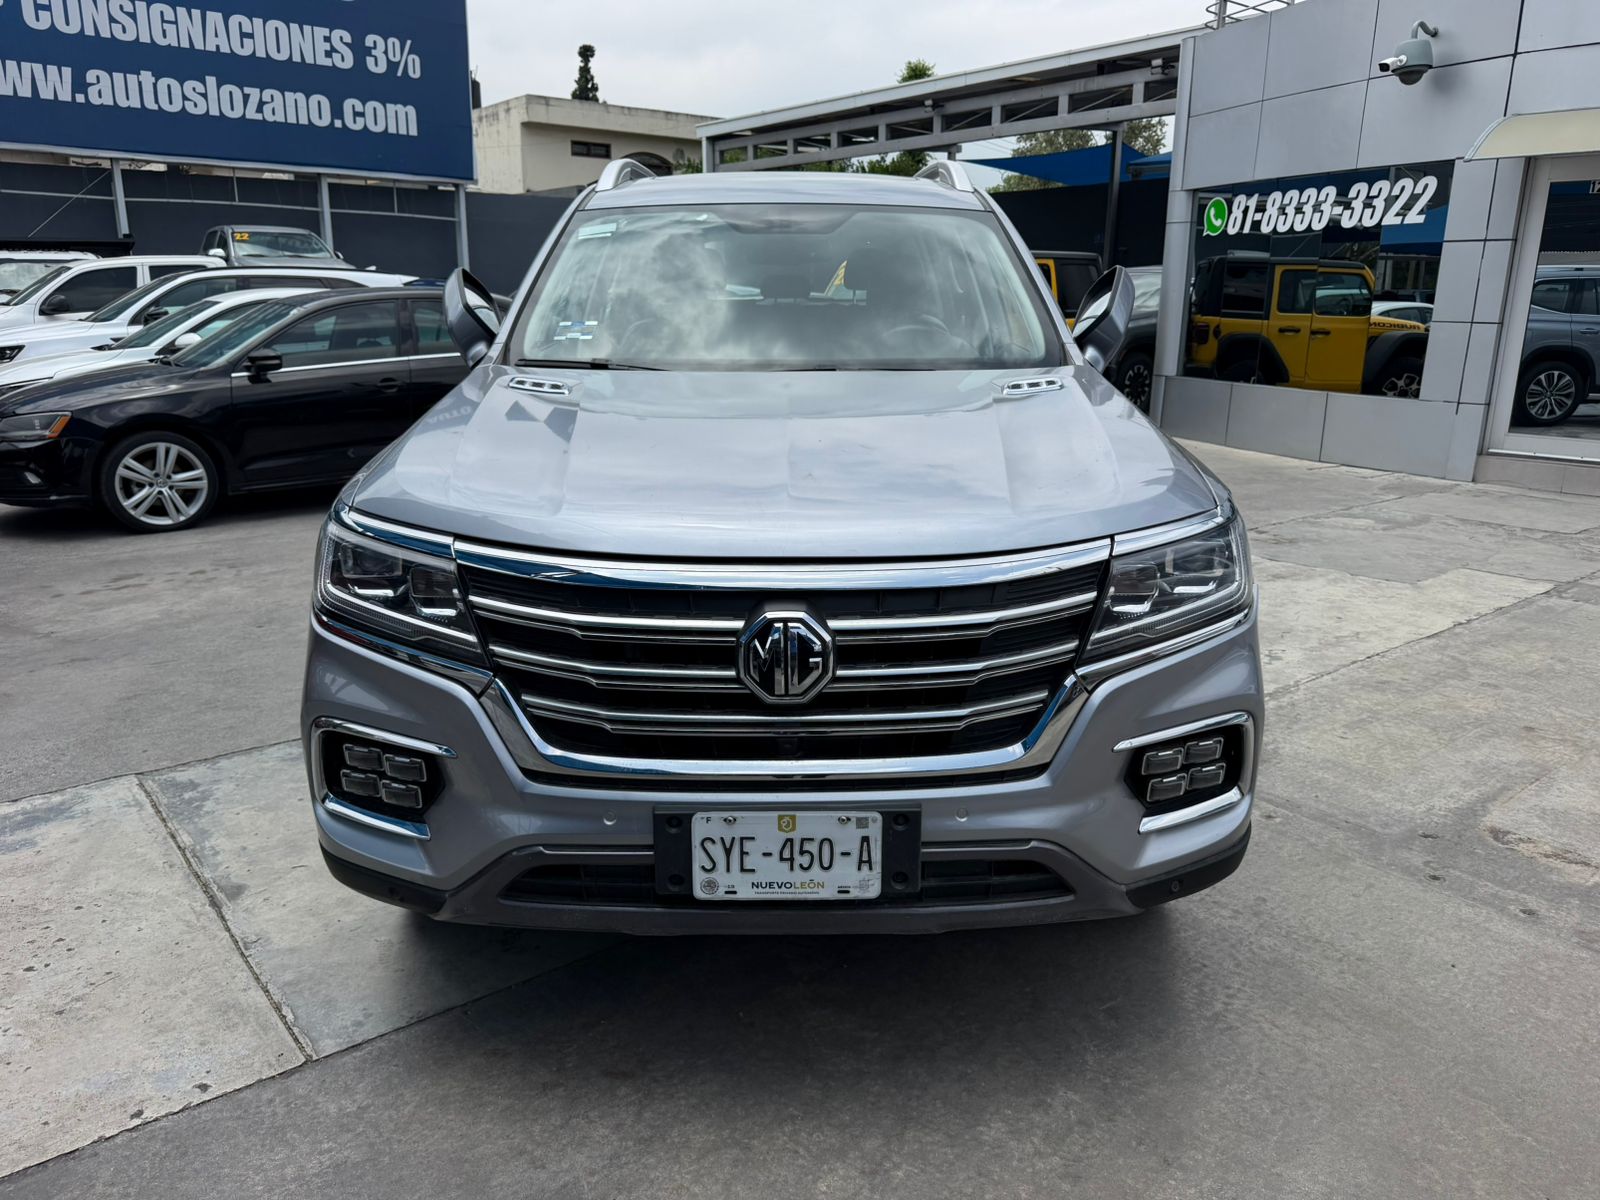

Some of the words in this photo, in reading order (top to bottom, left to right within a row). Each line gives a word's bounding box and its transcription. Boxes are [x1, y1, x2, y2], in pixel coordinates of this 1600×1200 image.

[20, 0, 355, 70] CONSIGNACIONES
[364, 34, 422, 79] 3%
[1226, 175, 1438, 236] 81-8333-3322
[750, 622, 823, 695] MG
[700, 836, 873, 873] SYE-450-A
